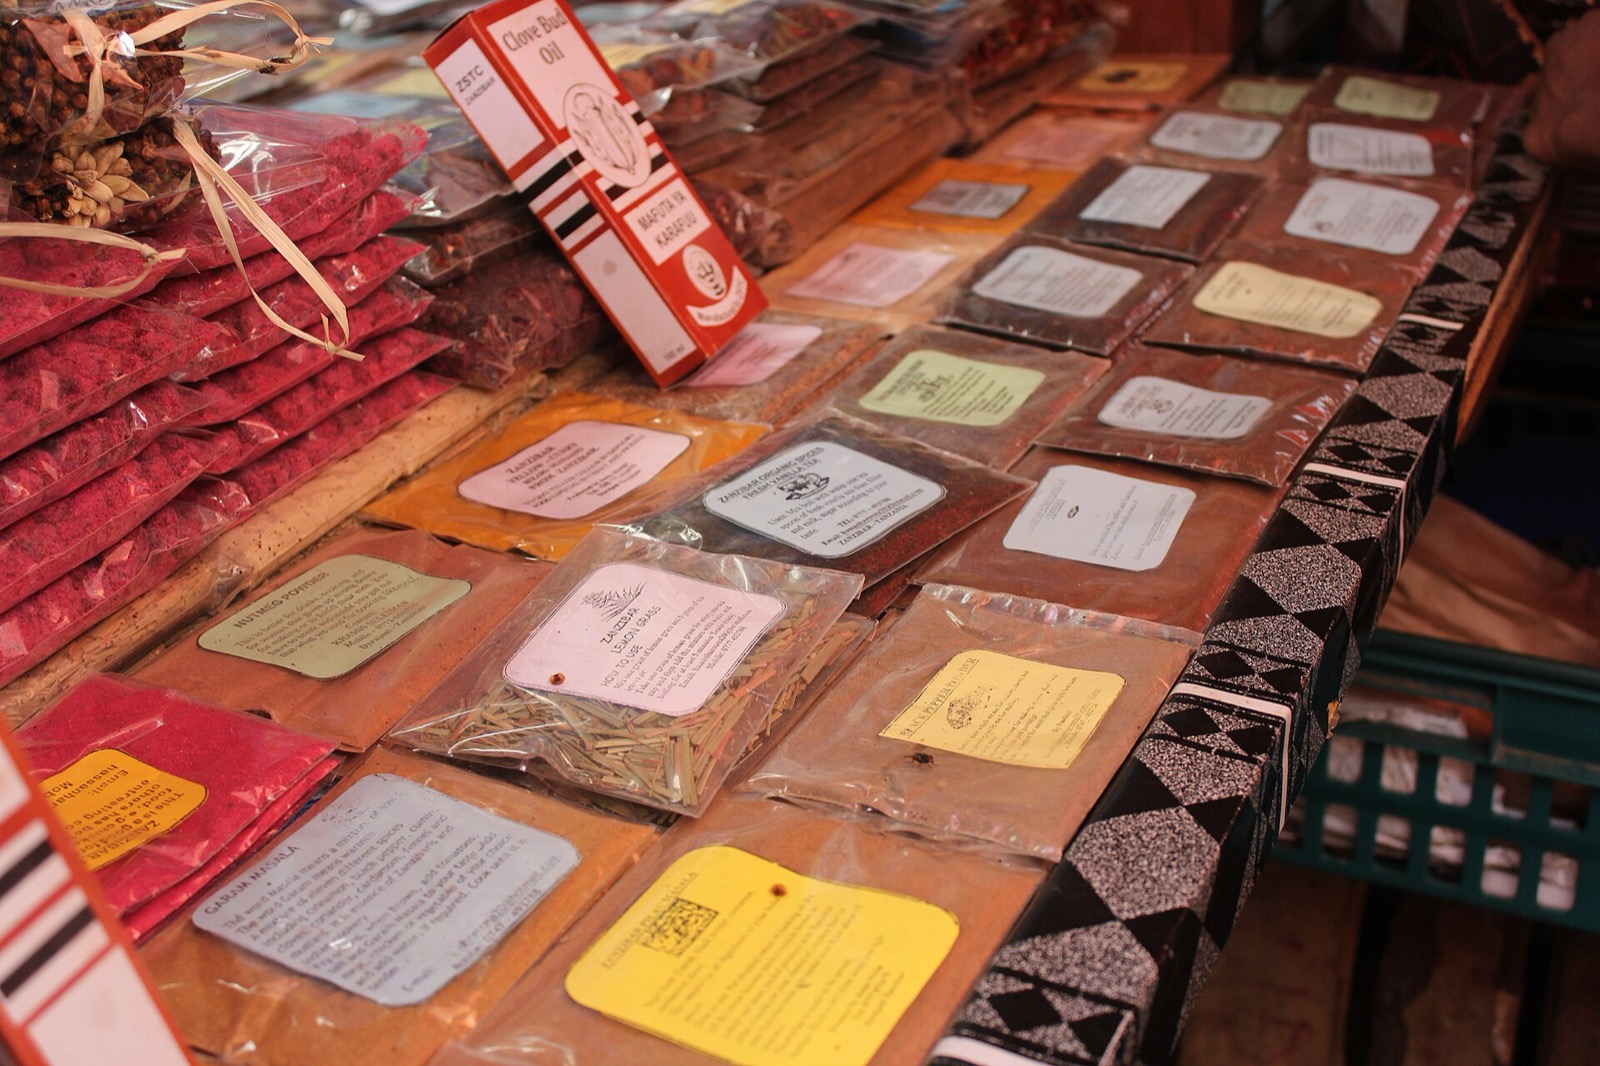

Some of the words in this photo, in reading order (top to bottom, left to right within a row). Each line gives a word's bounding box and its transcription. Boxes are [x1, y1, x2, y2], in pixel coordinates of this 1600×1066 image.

[502, 25, 542, 52] Clove
[536, 4, 569, 34] Bud
[538, 40, 565, 65] Oil
[455, 64, 484, 94] ZSTC
[637, 199, 675, 231] MAFUTA
[671, 190, 687, 205] YA
[655, 214, 697, 247] KARAFUU
[718, 479, 762, 504] ZANZIBAR
[758, 460, 798, 481] ORGANIC
[742, 482, 772, 500] FRESH
[802, 458, 819, 467] TEA
[233, 599, 284, 629] NUTMEG
[280, 572, 330, 601] POWDER
[599, 608, 638, 644] ZANZIBAR
[610, 627, 640, 654] LEMON
[635, 605, 662, 627] GRASS
[599, 669, 620, 687] HOW
[625, 644, 644, 659] USE
[119, 783, 161, 811] others
[154, 792, 185, 811] This
[93, 811, 121, 826] has
[375, 823, 405, 846] spices
[248, 845, 299, 881] MASALA
